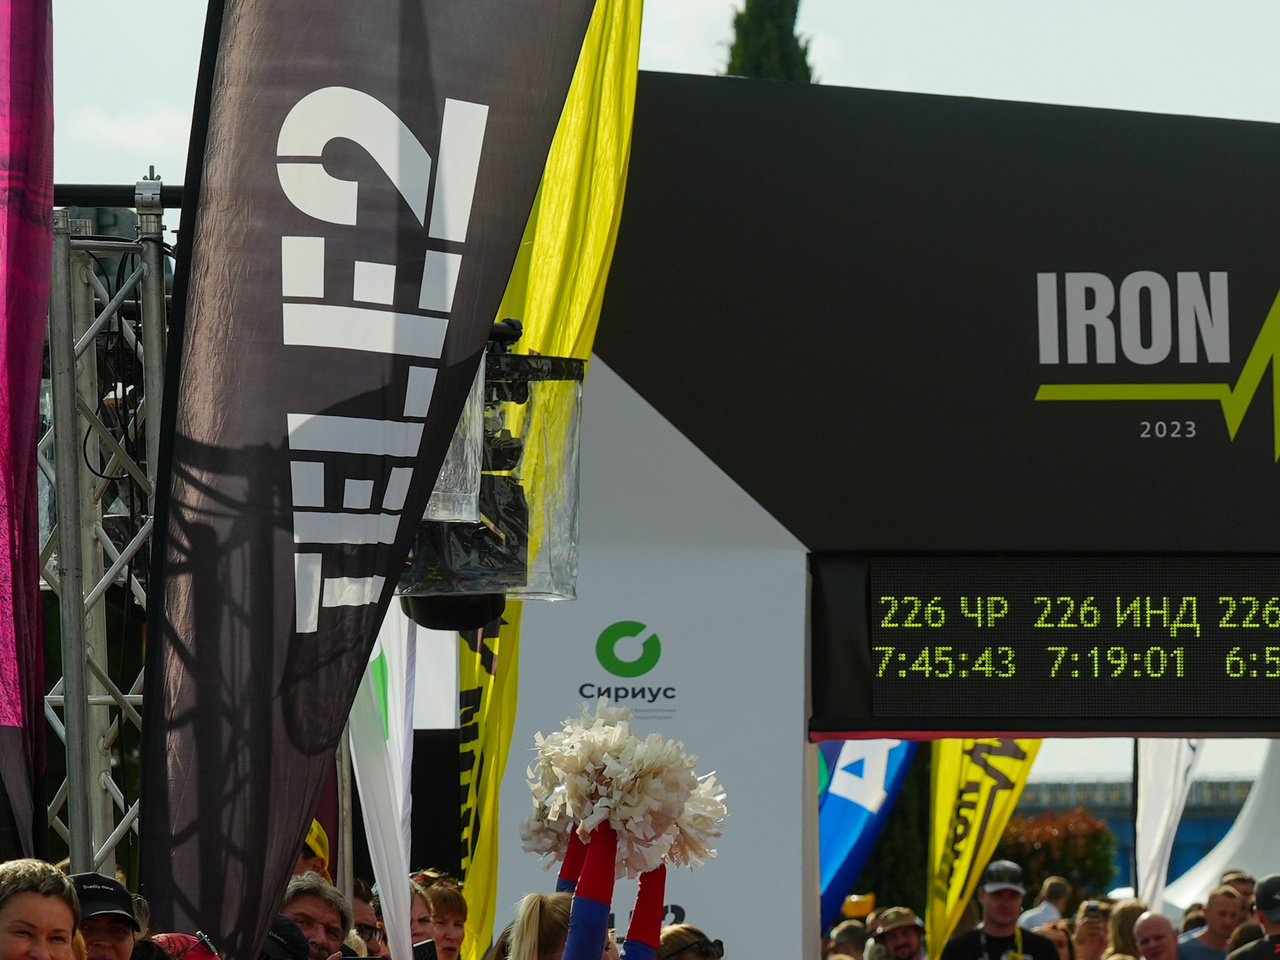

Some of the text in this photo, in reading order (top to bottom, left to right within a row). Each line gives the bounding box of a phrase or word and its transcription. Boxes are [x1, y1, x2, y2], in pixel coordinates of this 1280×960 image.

[1036, 270, 1230, 365] IRON
[277, 86, 489, 633] TELE2
[1139, 421, 1197, 438] 2023
[880, 596, 946, 627] 226
[960, 596, 1009, 627] ЧР
[1033, 596, 1101, 627] 226
[1115, 596, 1201, 637] ИНД
[872, 646, 1017, 678] 7:45:43
[1047, 646, 1186, 678] 7:19:01
[579, 683, 676, 703] Сириус
